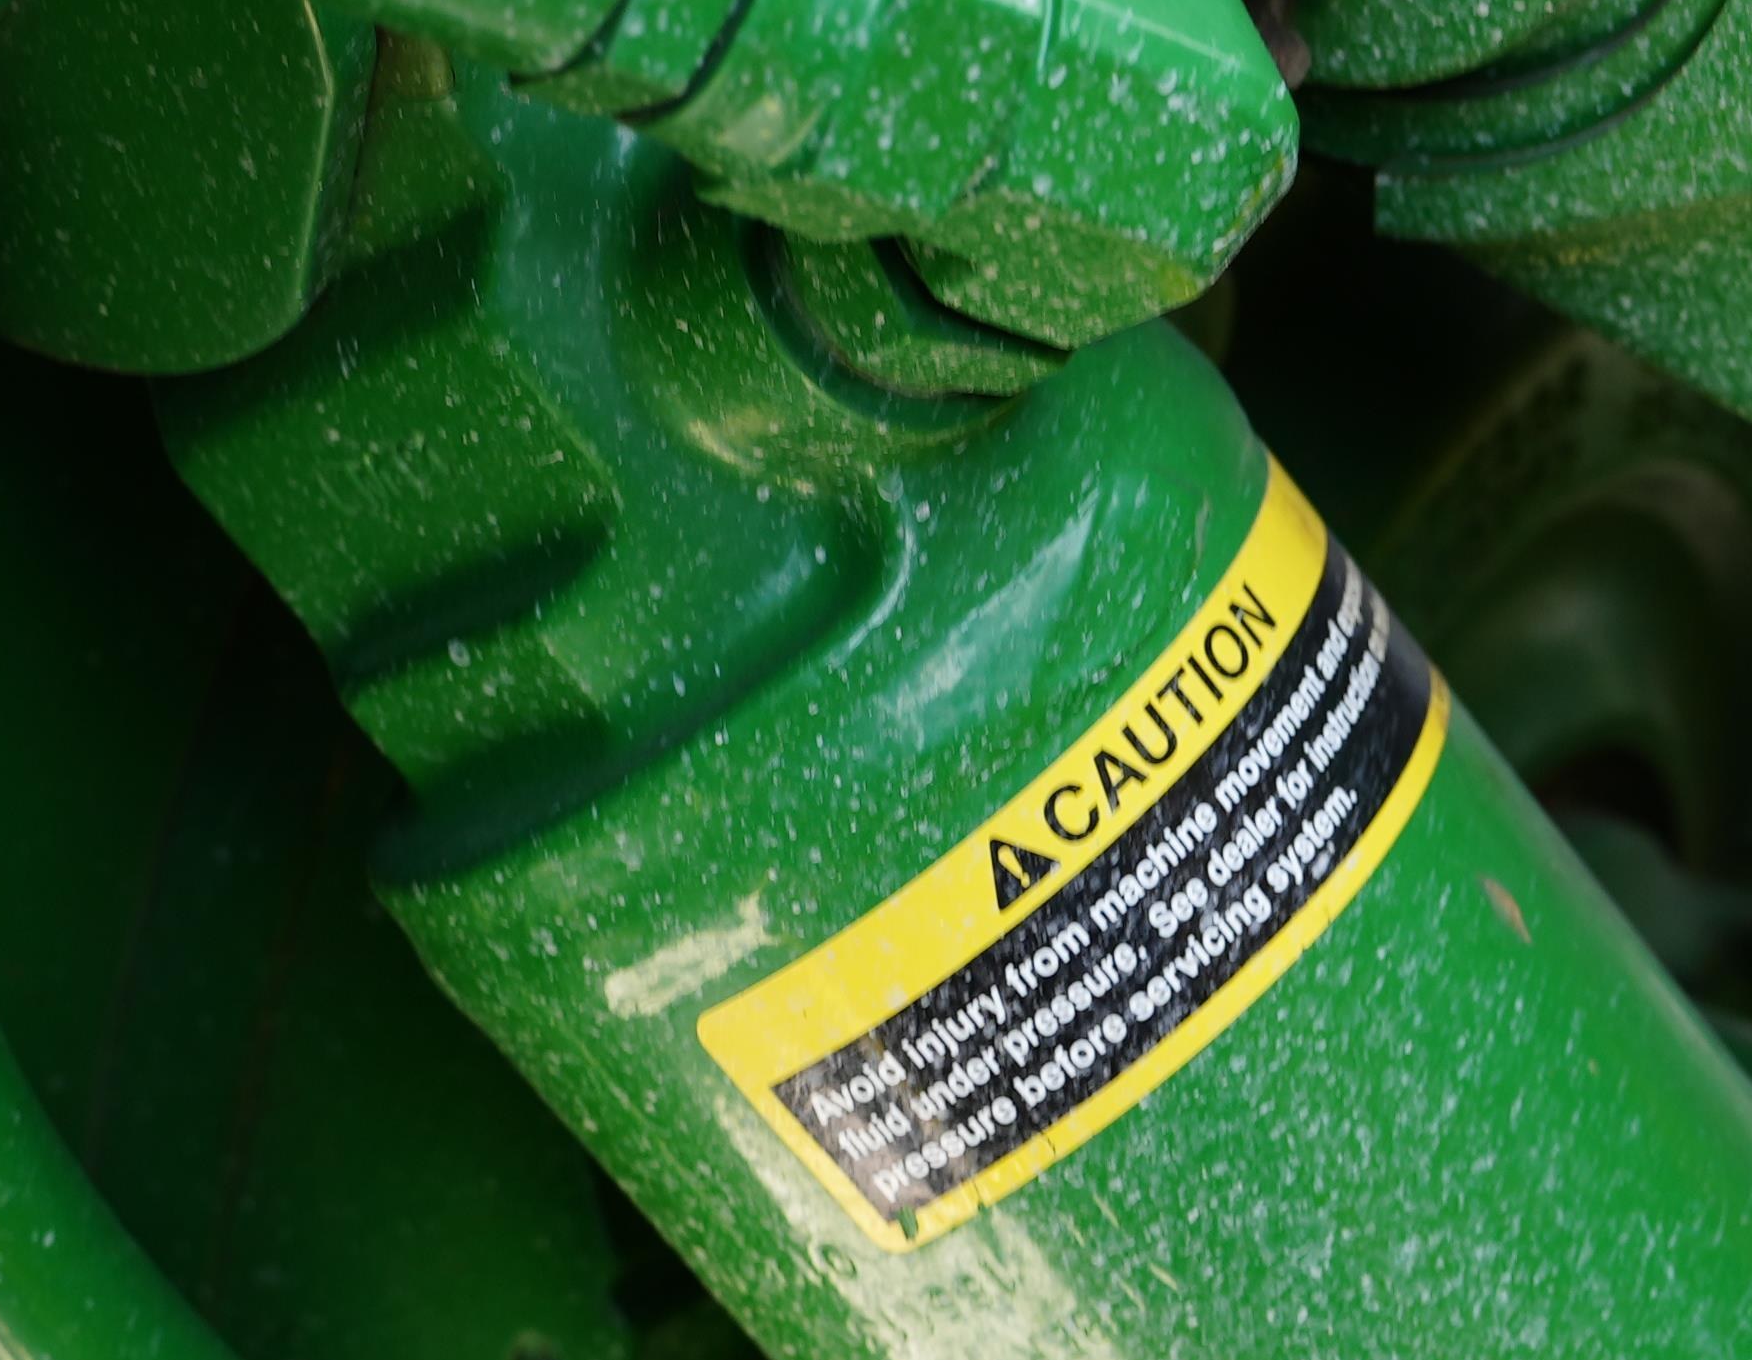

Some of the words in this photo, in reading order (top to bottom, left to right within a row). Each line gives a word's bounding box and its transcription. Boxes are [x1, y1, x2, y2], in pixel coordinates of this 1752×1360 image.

[810, 1050, 907, 1127] Avoid
[901, 984, 1006, 1070] injury
[1005, 921, 1091, 997] from
[1089, 802, 1218, 932] machine
[1215, 665, 1327, 814] movement
[1316, 618, 1349, 681] and
[838, 1102, 912, 1161] fluid
[910, 1045, 1000, 1121] under
[1003, 942, 1147, 1068] pressure.
[1148, 877, 1209, 938] See
[1207, 795, 1283, 887] dealer
[1276, 758, 1313, 810] for
[1303, 650, 1382, 773] instruction
[1044, 580, 1277, 841] CAUTION
[873, 1096, 1017, 1203] pressure
[1013, 1013, 1127, 1108] before
[1129, 883, 1271, 1022] servicing
[1266, 786, 1358, 893] system.
